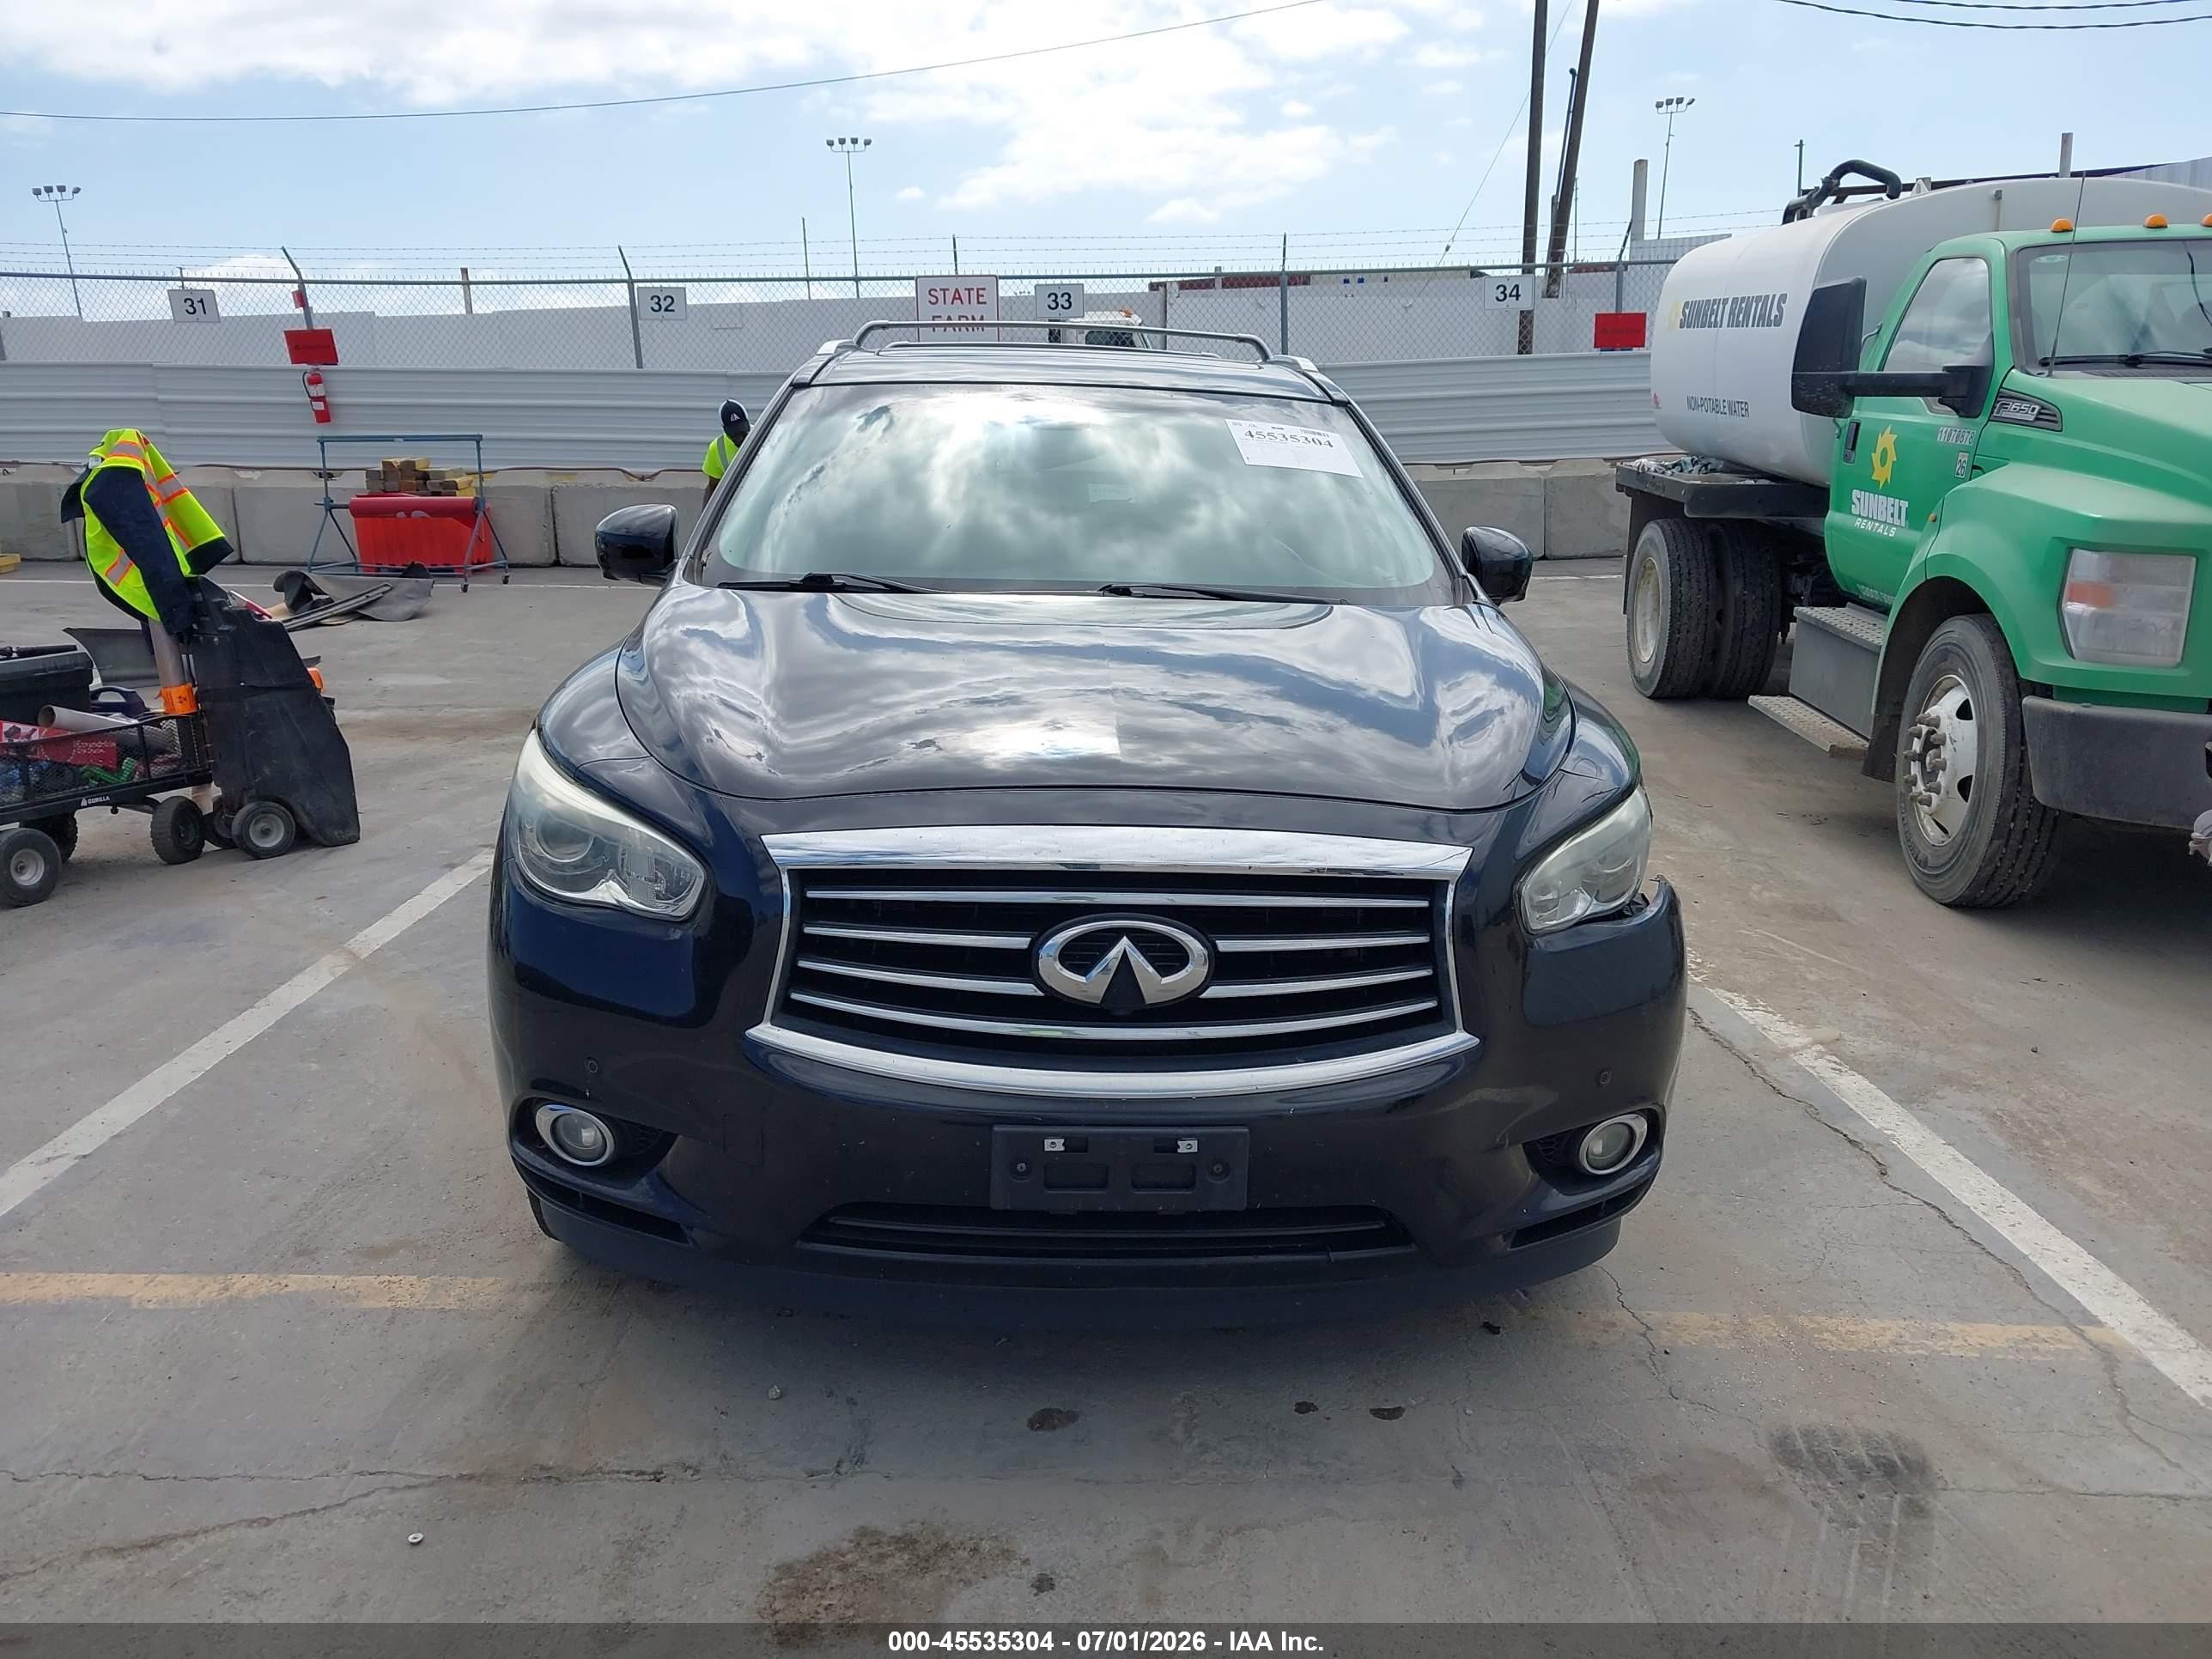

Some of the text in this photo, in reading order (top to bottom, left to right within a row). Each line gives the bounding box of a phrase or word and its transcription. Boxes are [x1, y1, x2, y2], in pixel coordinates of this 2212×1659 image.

[928, 288, 987, 305] STATE
[1047, 292, 1073, 310] 33
[1495, 284, 1521, 301] 34
[183, 298, 207, 315] 31
[650, 295, 675, 313] 32
[1679, 293, 1788, 329] SUNBELT RENTALS
[932, 314, 985, 332] FARM
[1686, 395, 1750, 418] NON-POTABLE WATER
[1244, 430, 1334, 448] 45535304
[1955, 459, 1966, 477] 26
[1851, 489, 1909, 527] SUNBELT
[1855, 518, 1897, 537] RENTALS
[88, 795, 110, 805] GORILLA
